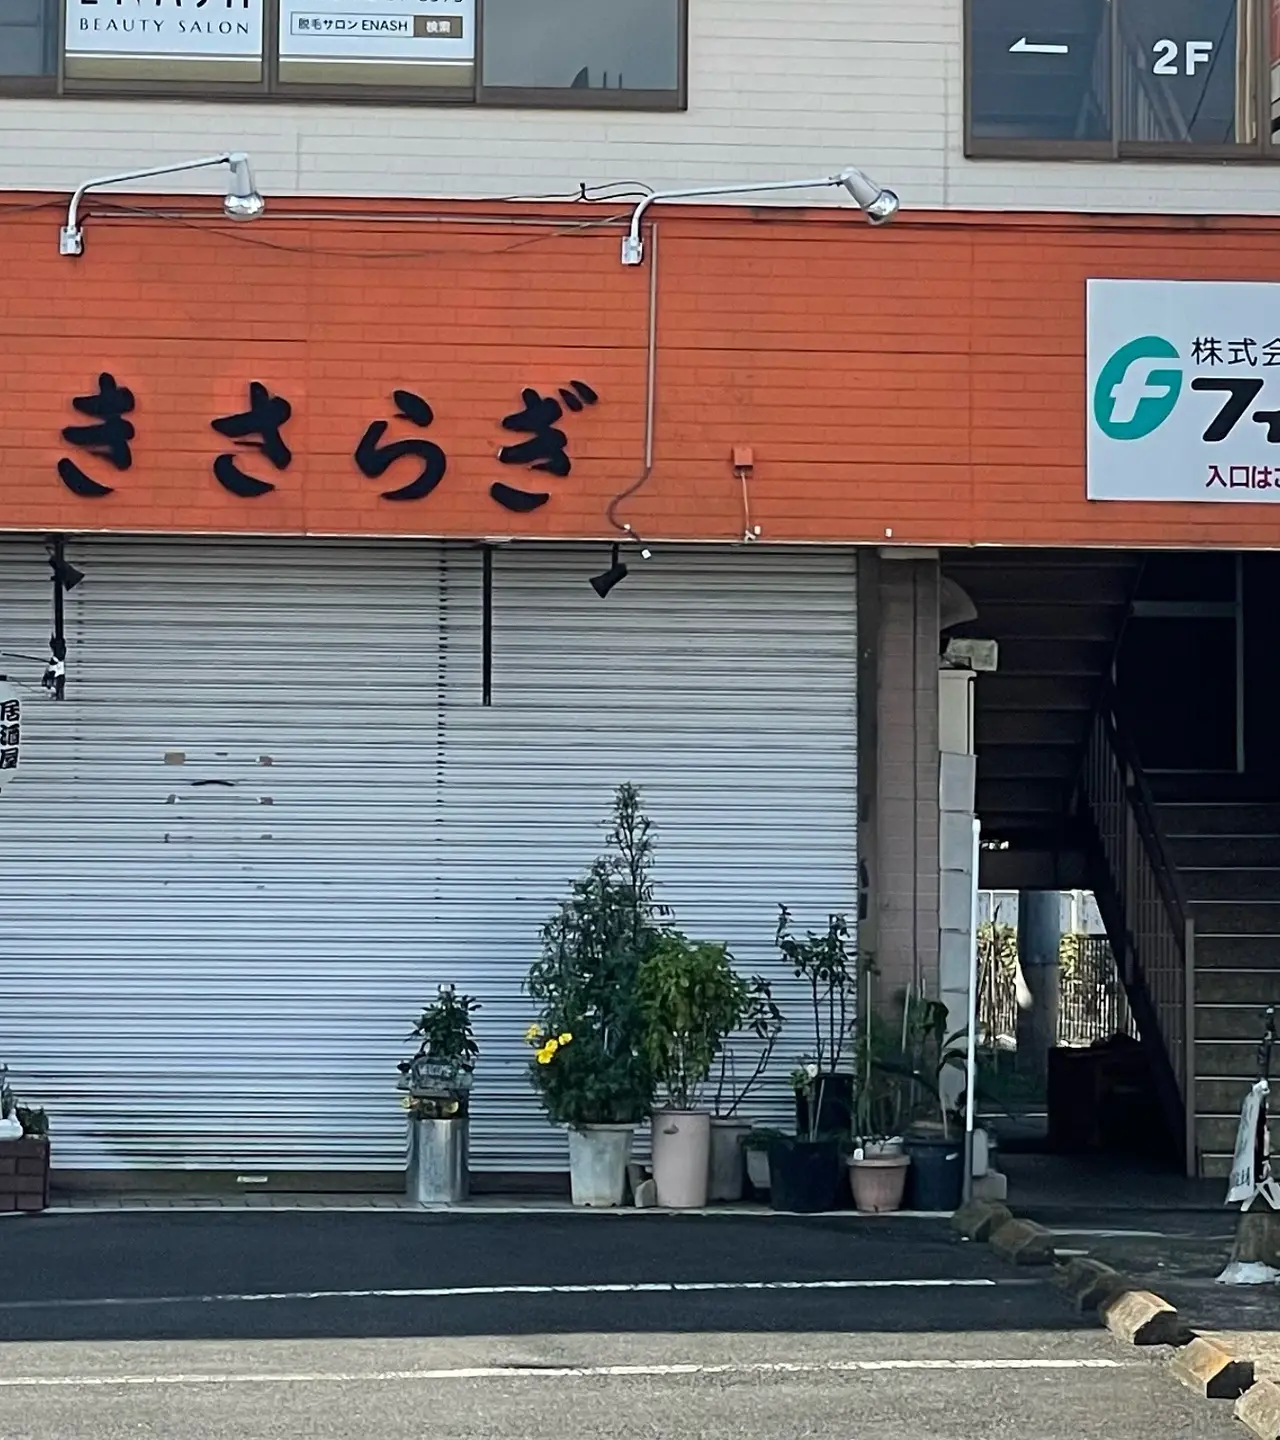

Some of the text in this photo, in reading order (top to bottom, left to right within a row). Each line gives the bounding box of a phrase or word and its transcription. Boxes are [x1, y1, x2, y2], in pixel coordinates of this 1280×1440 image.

[80, 17, 249, 35] BEAUTY SALON
[1153, 39, 1212, 76] 2F
[57, 372, 598, 512] きさらぎ
